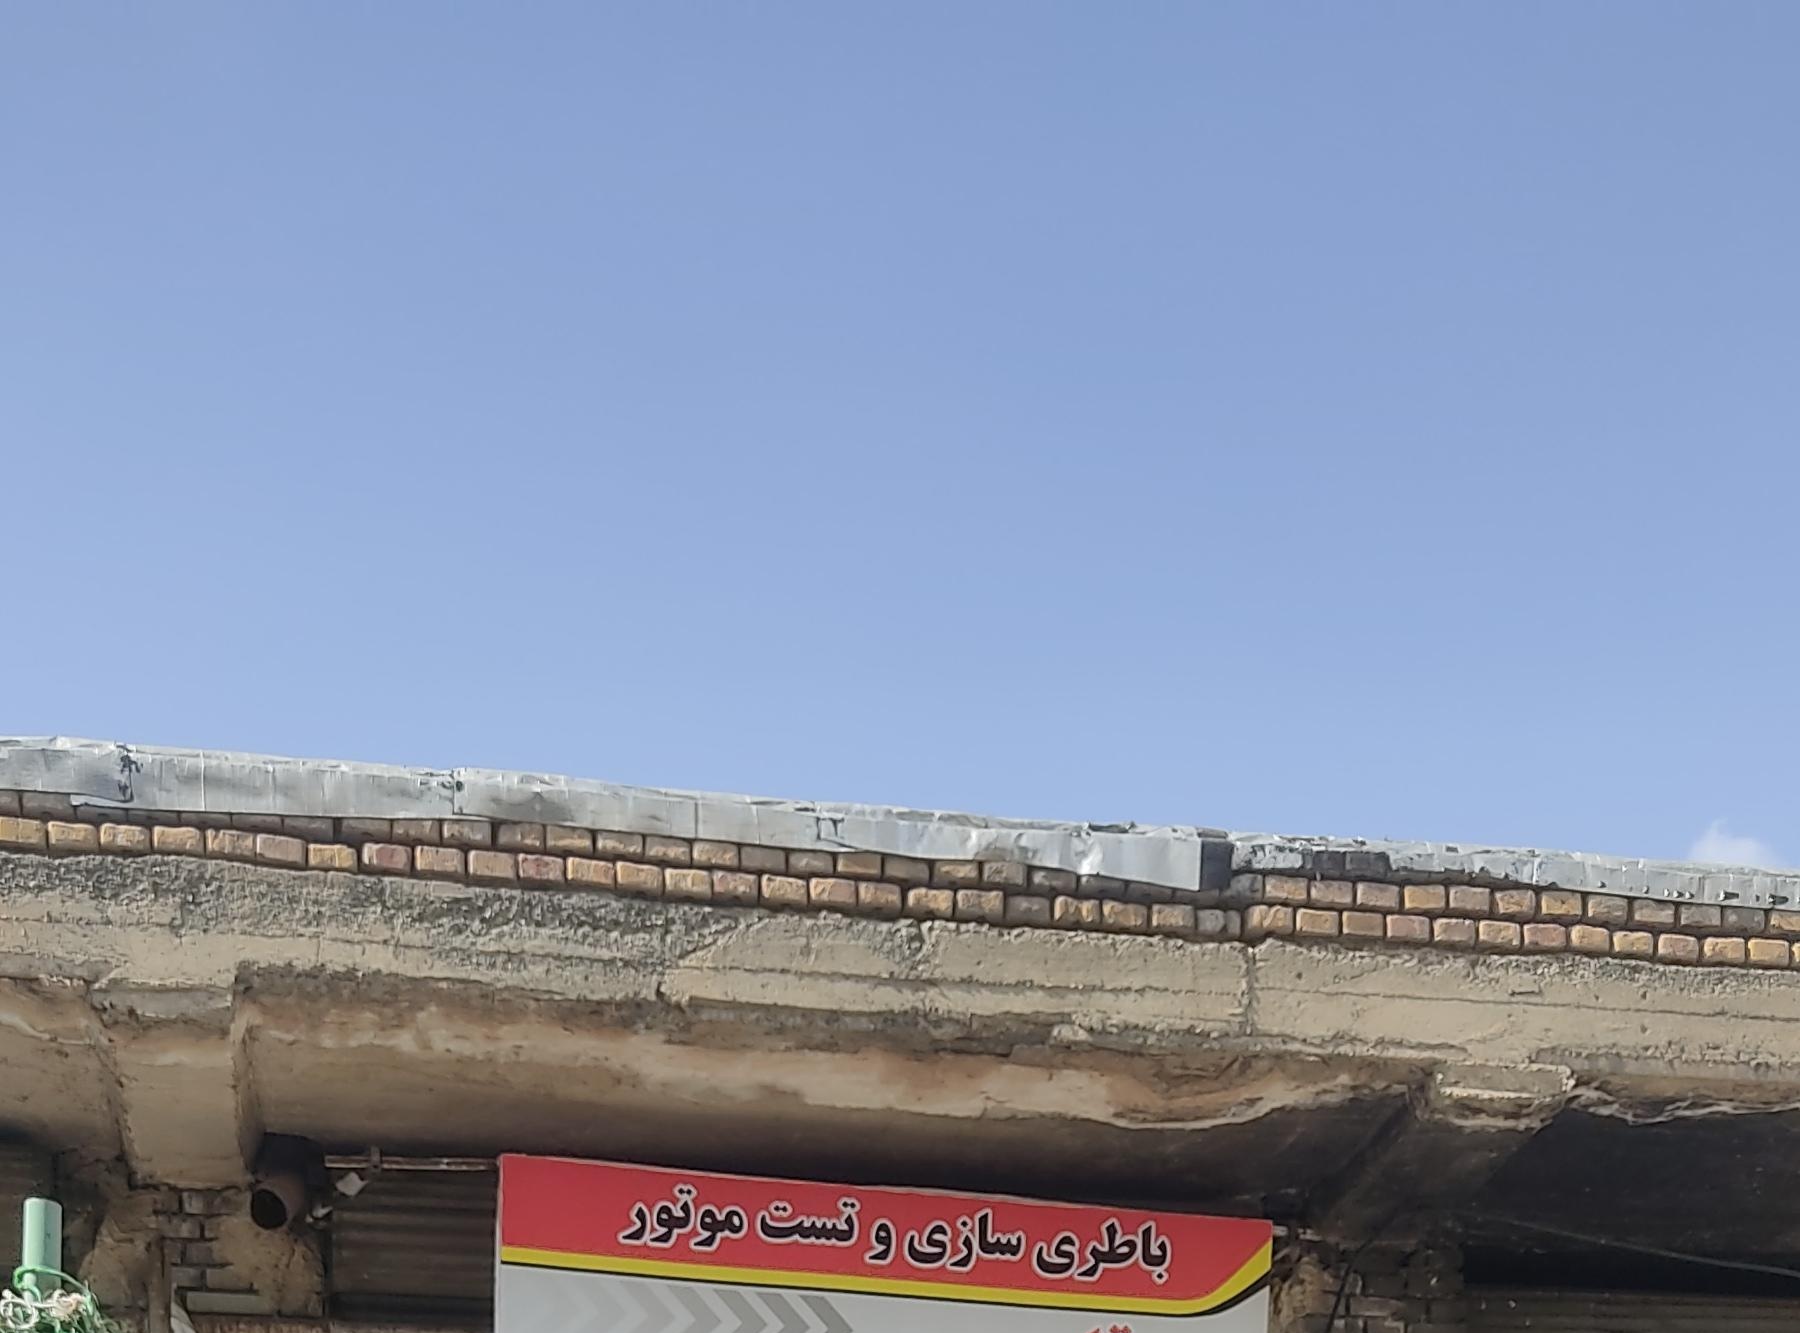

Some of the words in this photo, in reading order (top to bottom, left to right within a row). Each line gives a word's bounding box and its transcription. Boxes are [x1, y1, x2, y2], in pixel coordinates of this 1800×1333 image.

[620, 1186, 745, 1248] موتور
[759, 1199, 857, 1243] تست
[867, 1221, 893, 1262] و
[906, 1210, 1024, 1269] سازی
[1033, 1220, 1169, 1282] باطری
